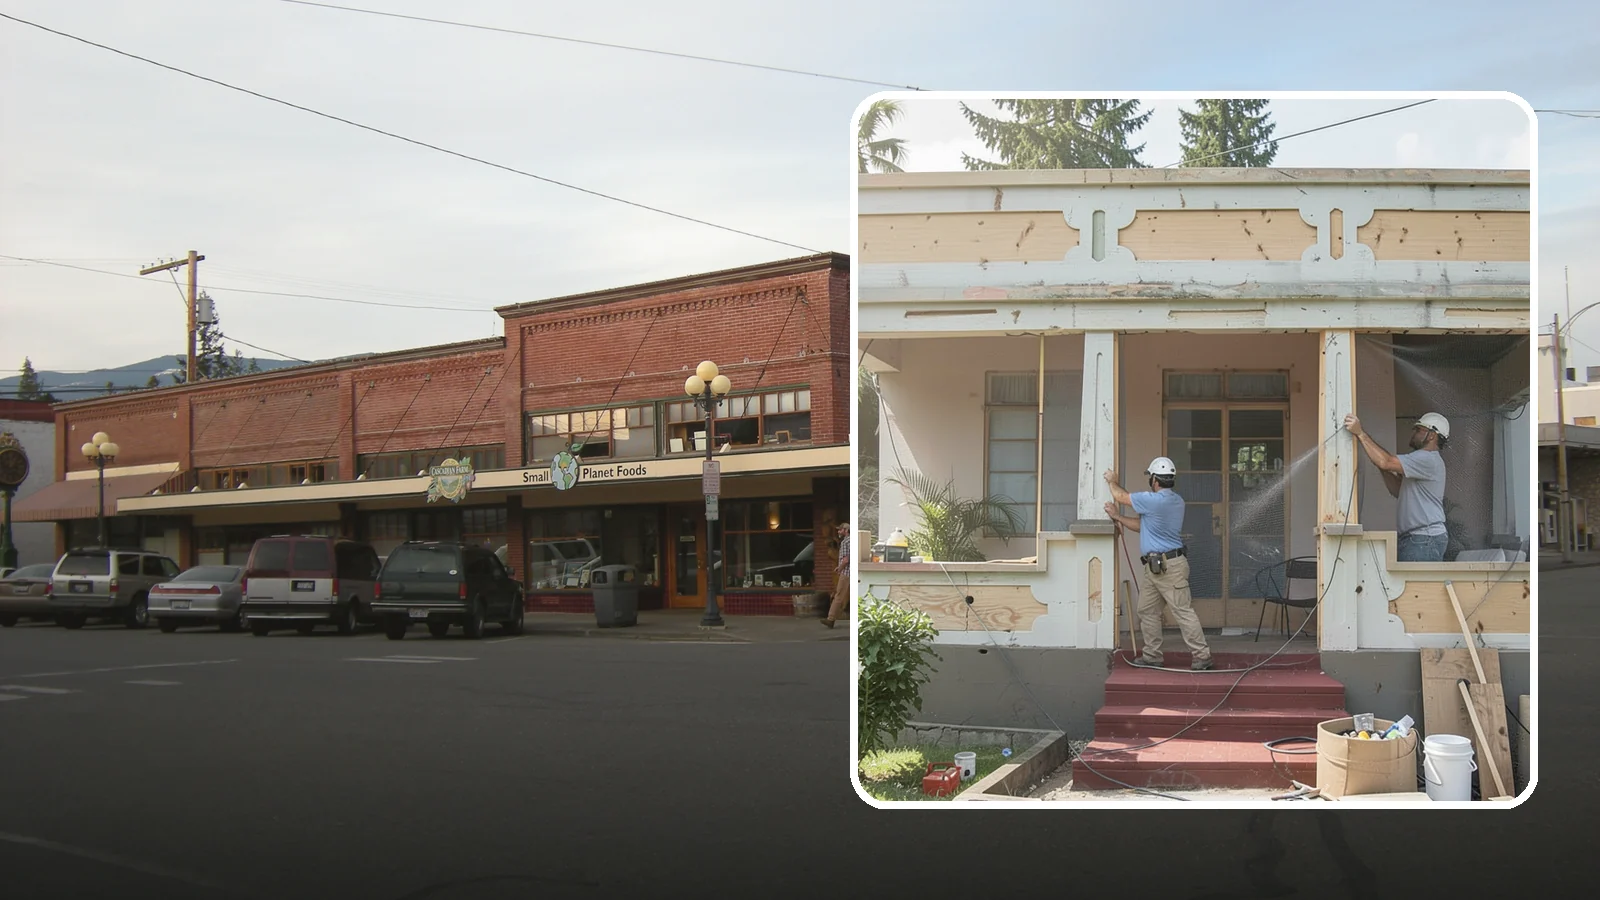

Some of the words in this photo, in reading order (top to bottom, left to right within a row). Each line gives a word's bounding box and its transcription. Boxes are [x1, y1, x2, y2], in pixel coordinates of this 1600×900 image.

[523, 471, 549, 483] Small
[582, 467, 614, 479] Planet
[616, 464, 647, 477] Foods
